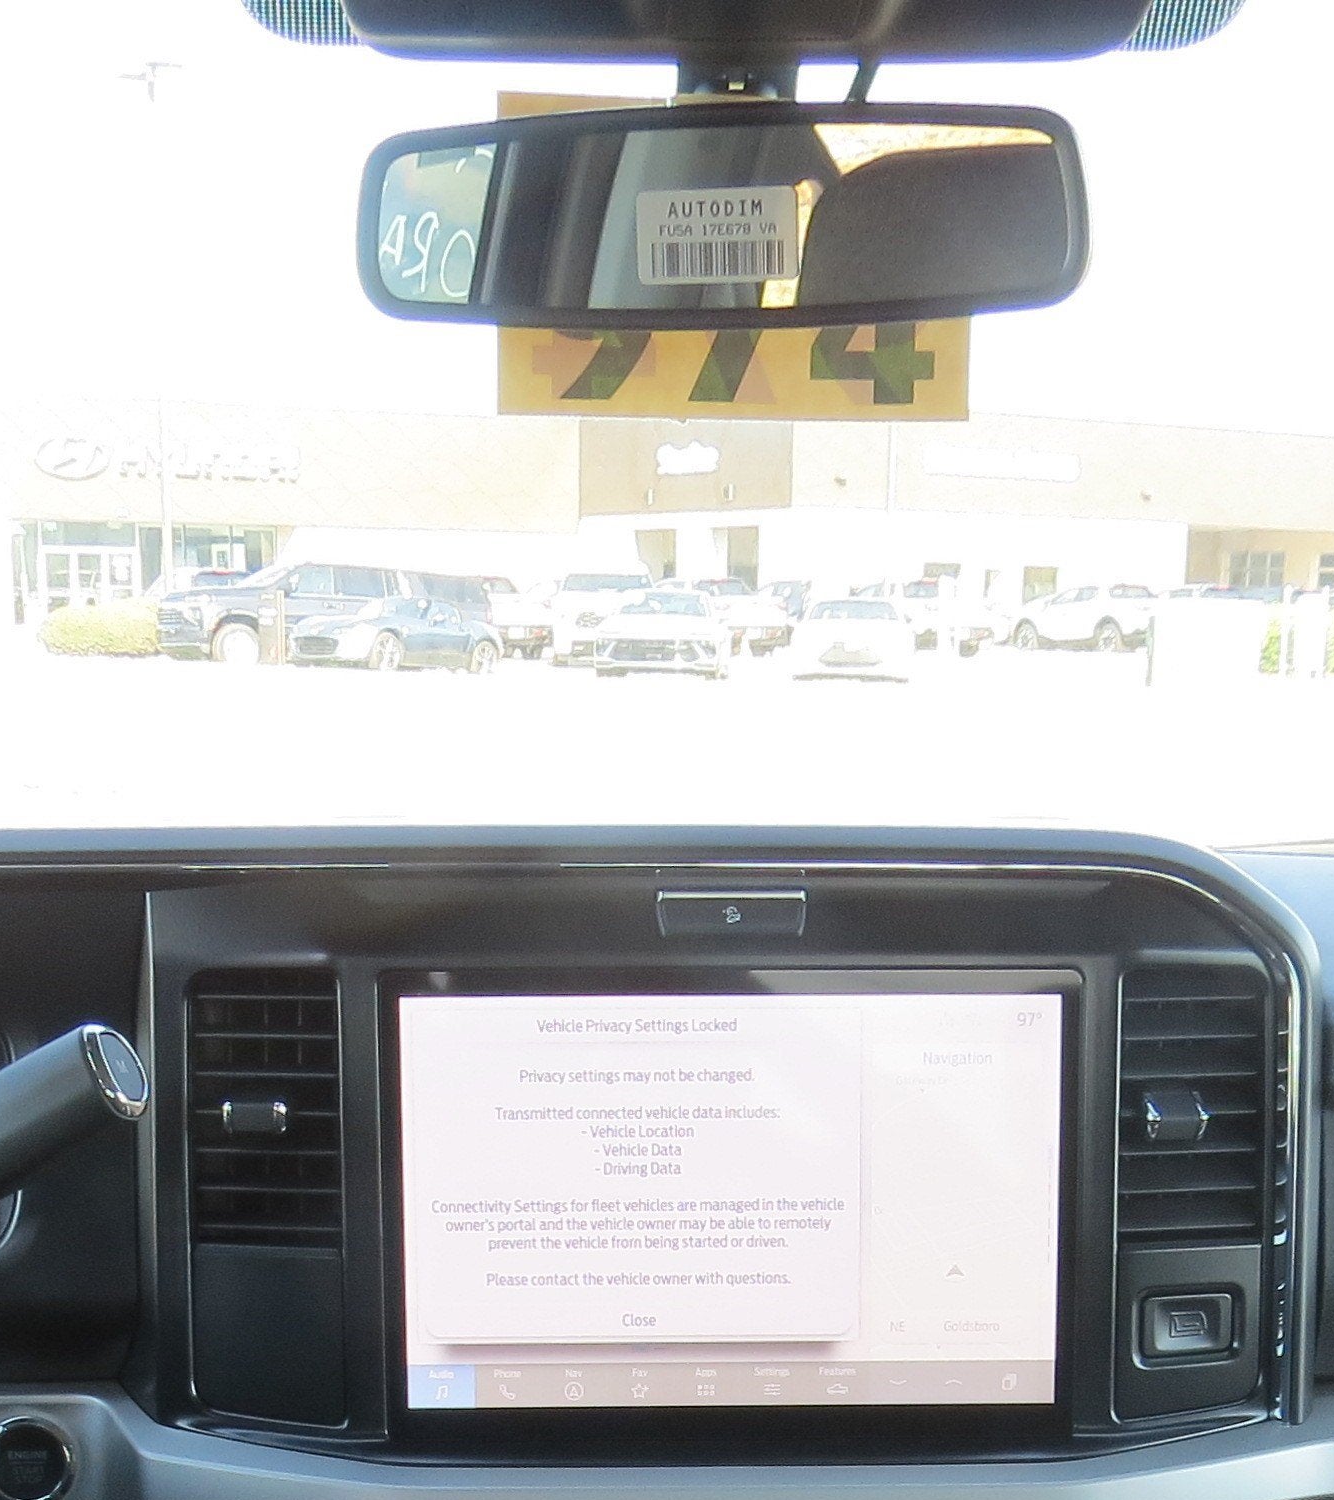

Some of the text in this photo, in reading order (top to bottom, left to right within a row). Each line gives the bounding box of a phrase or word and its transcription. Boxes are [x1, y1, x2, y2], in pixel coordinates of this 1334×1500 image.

[668, 199, 763, 218] AUTODIM
[759, 222, 777, 234] VA
[536, 1017, 738, 1035] Vehicle Privacy Settings Locked
[922, 1051, 993, 1068] Navigation
[519, 1067, 756, 1086] Privacy settings may not be changed.
[494, 1104, 781, 1121] Transmitted connected vehicle data includes:
[588, 1123, 695, 1139] Vehicle Location
[601, 1142, 683, 1158] Vehicle Data
[603, 1161, 682, 1178] Driving Data
[431, 1196, 845, 1216] Connectivity Settings for fleet vehicles are managed in the vehicle
[445, 1214, 832, 1234] owner's portal and the vehicle owner may be able to remotely
[487, 1233, 789, 1252] prevent the vehicle from being started or driven.
[485, 1270, 792, 1288] Please contact the vehicle owner with questions.
[621, 1313, 657, 1328] Close
